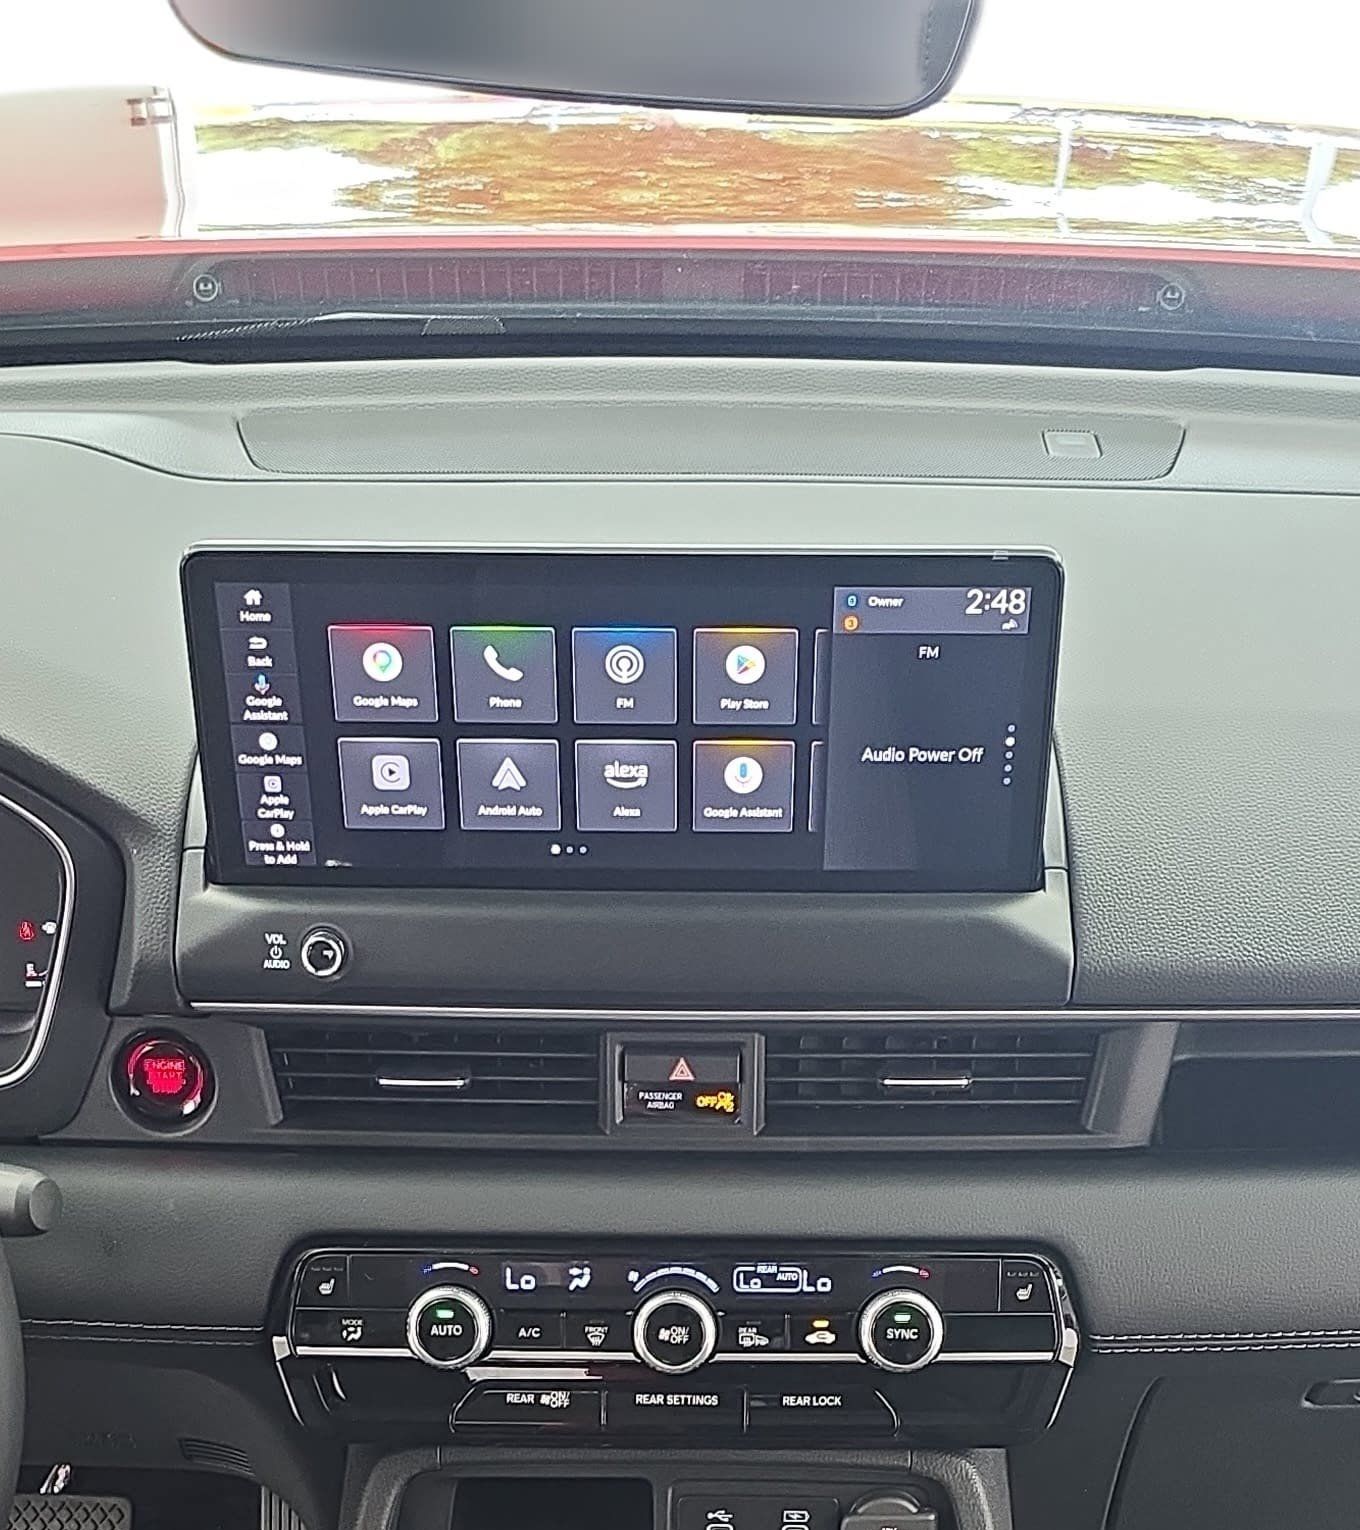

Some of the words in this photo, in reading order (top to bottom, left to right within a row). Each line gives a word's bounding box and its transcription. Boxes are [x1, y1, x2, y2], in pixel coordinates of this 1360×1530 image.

[868, 596, 904, 608] Owner
[964, 589, 1026, 615] 2:48
[240, 611, 271, 622] Home
[918, 647, 939, 659] FM
[248, 656, 272, 667] Back
[246, 696, 282, 708] Google
[353, 696, 389, 709] Google
[391, 697, 418, 708] Maps
[489, 697, 521, 708] Phone
[616, 697, 634, 708] FM
[720, 698, 741, 711] Play
[743, 698, 768, 710] Store
[244, 709, 288, 720] Assistant
[238, 754, 273, 766] Google
[275, 755, 302, 766] Maps
[861, 748, 904, 762] Audio
[909, 748, 955, 762] Power
[959, 748, 984, 762] Off
[261, 794, 289, 806] Apple
[257, 808, 295, 820] CarPlay
[360, 805, 388, 816] Apple
[391, 804, 427, 817] CarPlay
[478, 805, 516, 816] Android
[519, 806, 542, 816] Auto
[613, 805, 641, 817] Alexa
[703, 807, 737, 819] Google
[740, 807, 783, 818] Assistant
[265, 934, 286, 945] VOL
[264, 959, 290, 969] AUDIO
[697, 1096, 716, 1108] OFF
[505, 1267, 535, 1290] Lo
[740, 1272, 761, 1288] Lo
[802, 1269, 832, 1292] Lo
[430, 1324, 462, 1336] AUTO
[519, 1328, 540, 1337] A/C
[670, 1327, 689, 1335] ON/
[886, 1328, 919, 1340] SYNC
[670, 1335, 689, 1344] OFF
[507, 1394, 534, 1404] REAR
[636, 1394, 664, 1405] REAR
[667, 1394, 719, 1406] SETTINGS
[782, 1396, 809, 1407] REAR
[812, 1396, 841, 1407] LOCK
